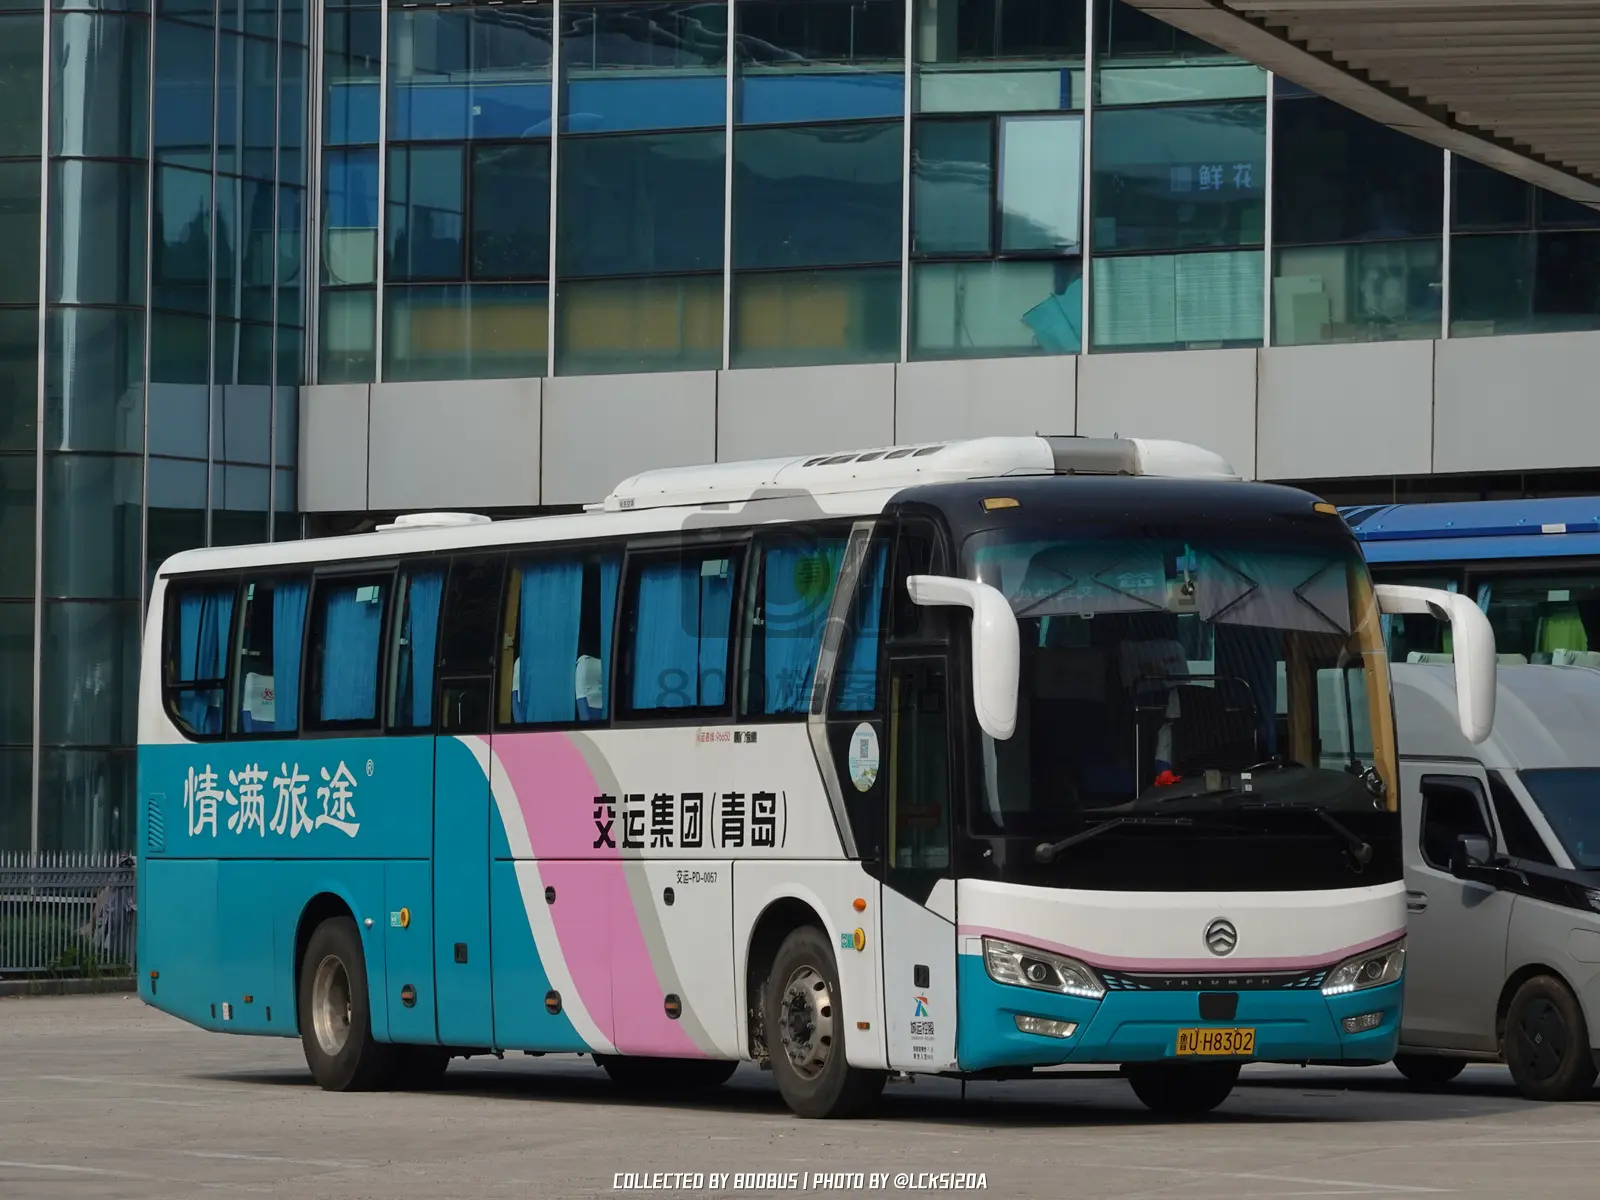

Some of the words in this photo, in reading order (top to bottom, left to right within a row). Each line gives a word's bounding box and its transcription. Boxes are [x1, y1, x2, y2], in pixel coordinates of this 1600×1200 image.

[1199, 163, 1252, 190] 鲜花
[183, 760, 361, 839] 情满旅途
[1164, 978, 1271, 986] TRIUMPH
